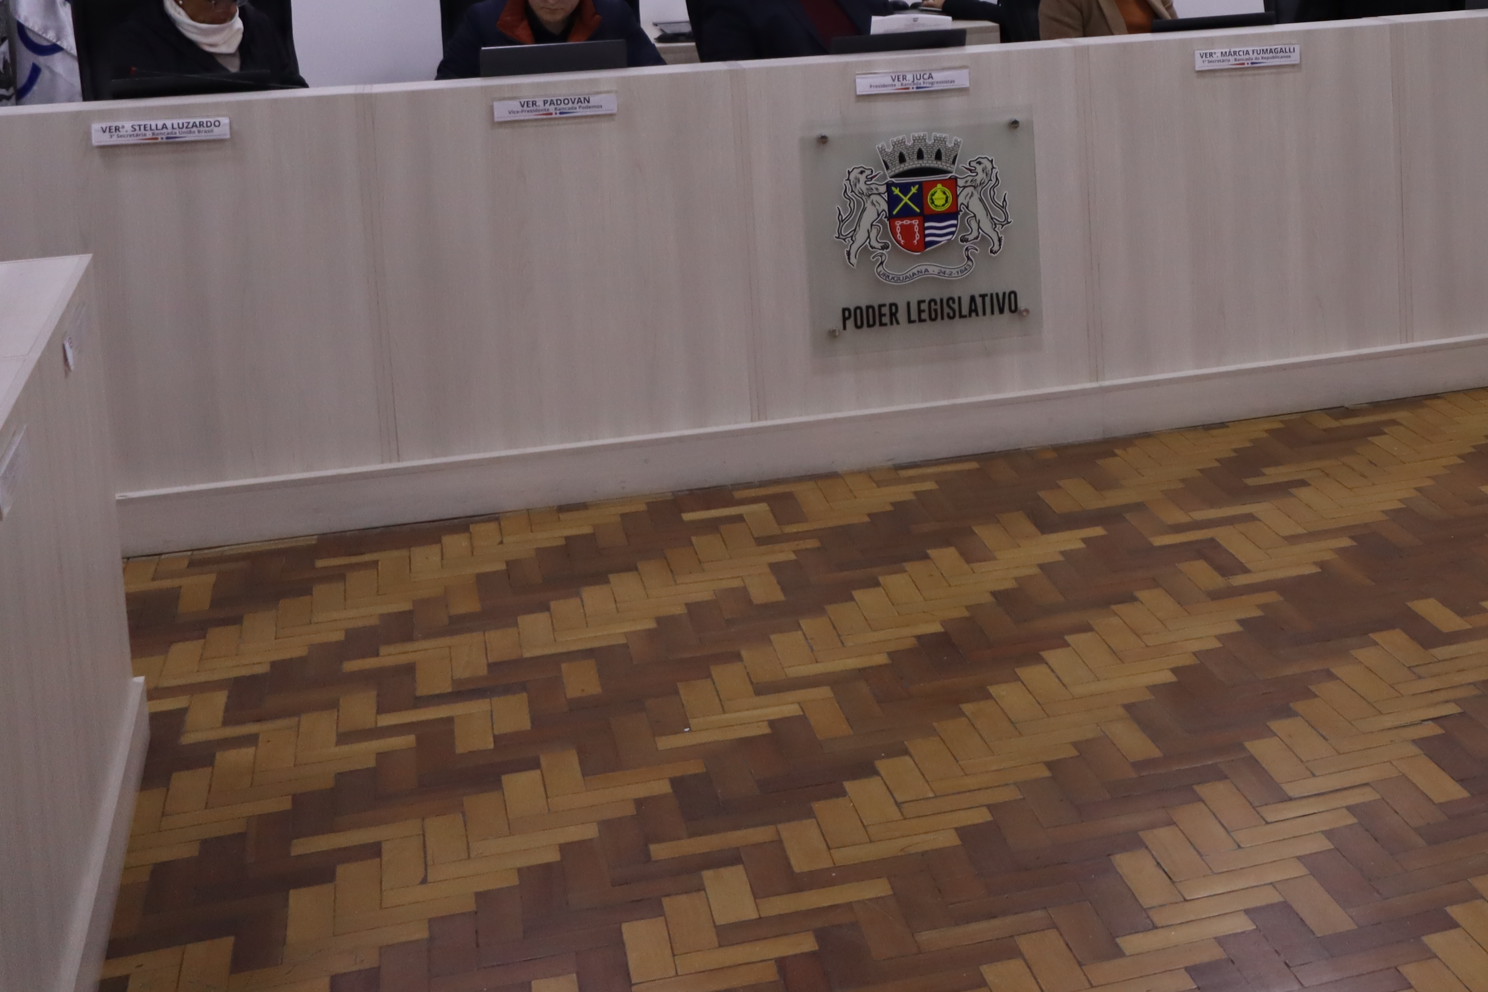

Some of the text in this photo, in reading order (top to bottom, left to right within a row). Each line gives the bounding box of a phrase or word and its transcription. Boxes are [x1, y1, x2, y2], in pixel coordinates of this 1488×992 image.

[1220, 48, 1250, 57] MÁRCIA
[1251, 47, 1296, 56] FUMAGALLI
[890, 72, 934, 83] VER. JUCA
[519, 96, 590, 109] VER. PADOVAN
[131, 122, 168, 133] STELLA
[171, 119, 221, 130] LUZARDO
[842, 289, 1019, 330] PODER LEGISLATIVO
